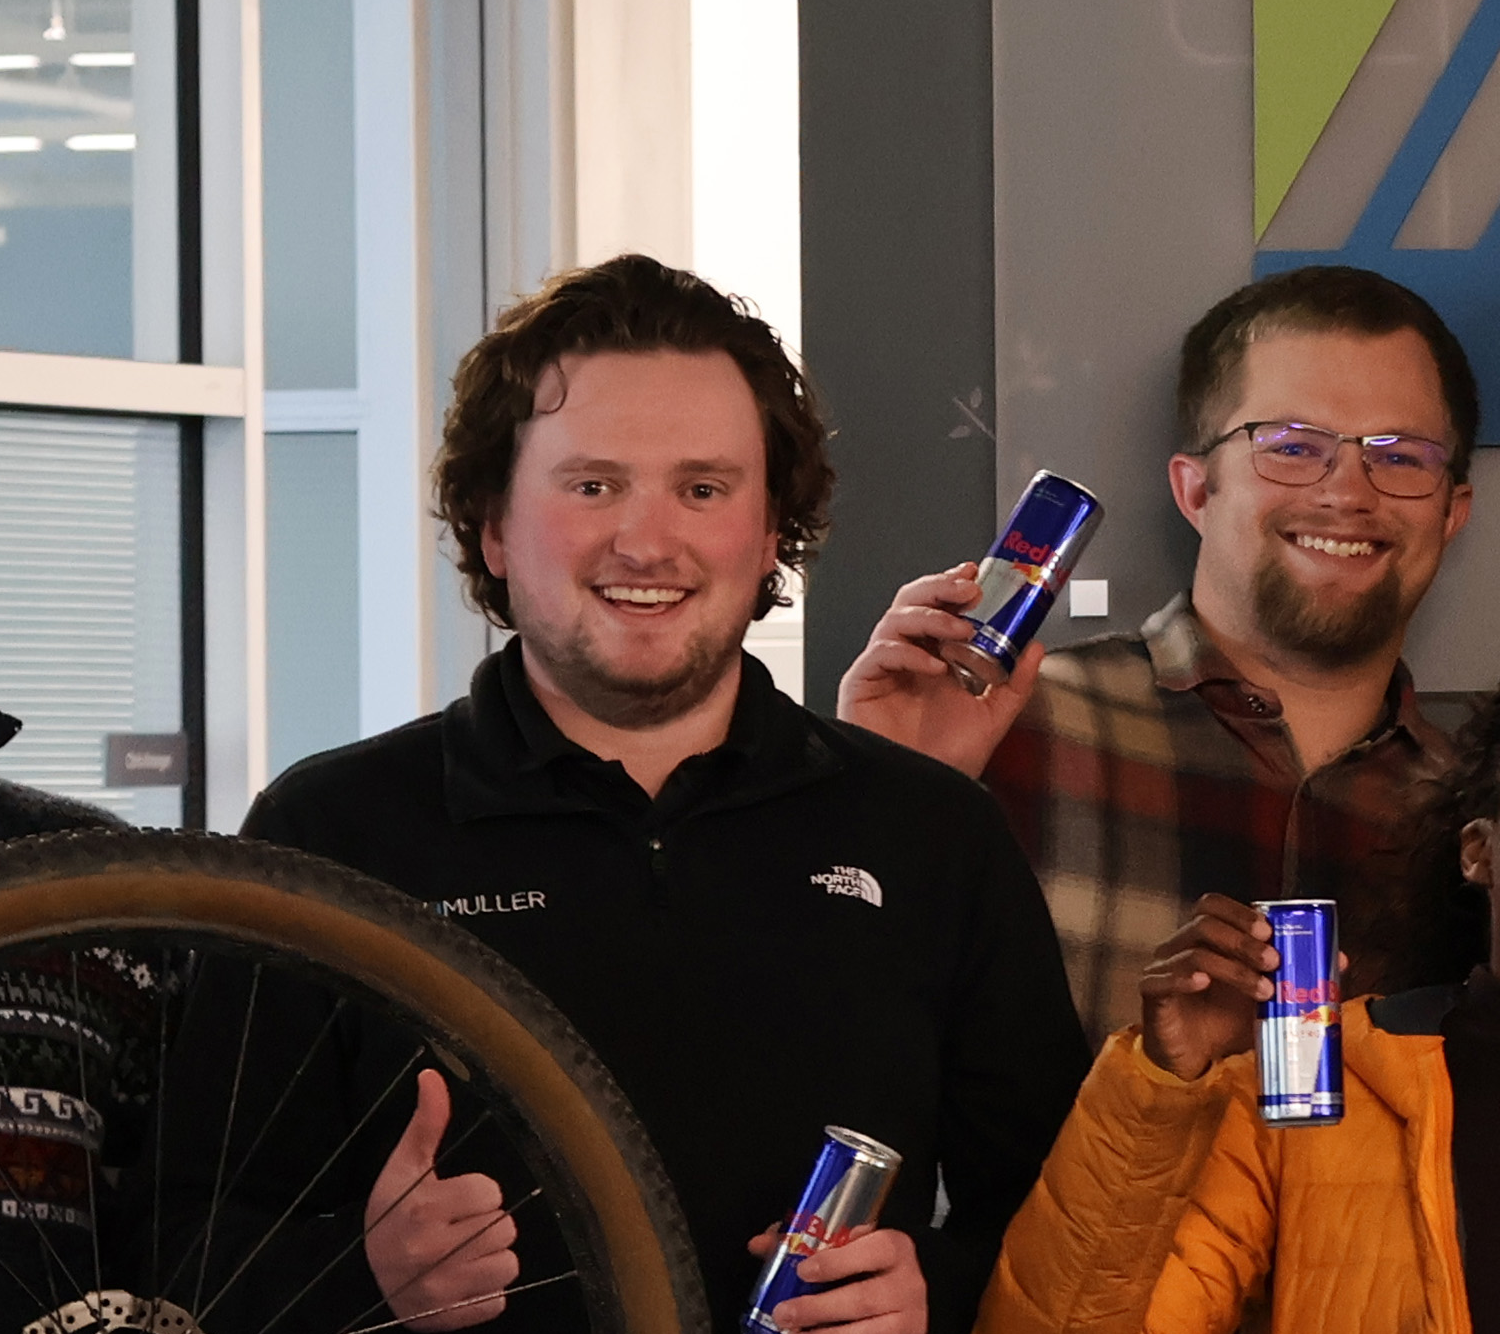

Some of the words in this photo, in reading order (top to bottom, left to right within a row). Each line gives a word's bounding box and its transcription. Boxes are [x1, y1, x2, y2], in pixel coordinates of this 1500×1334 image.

[1003, 530, 1050, 563] Red
[810, 873, 860, 887] NORTH
[830, 865, 860, 876] THE
[826, 884, 862, 899] FACE
[442, 890, 547, 918] MULLER
[1276, 979, 1326, 1004] Red
